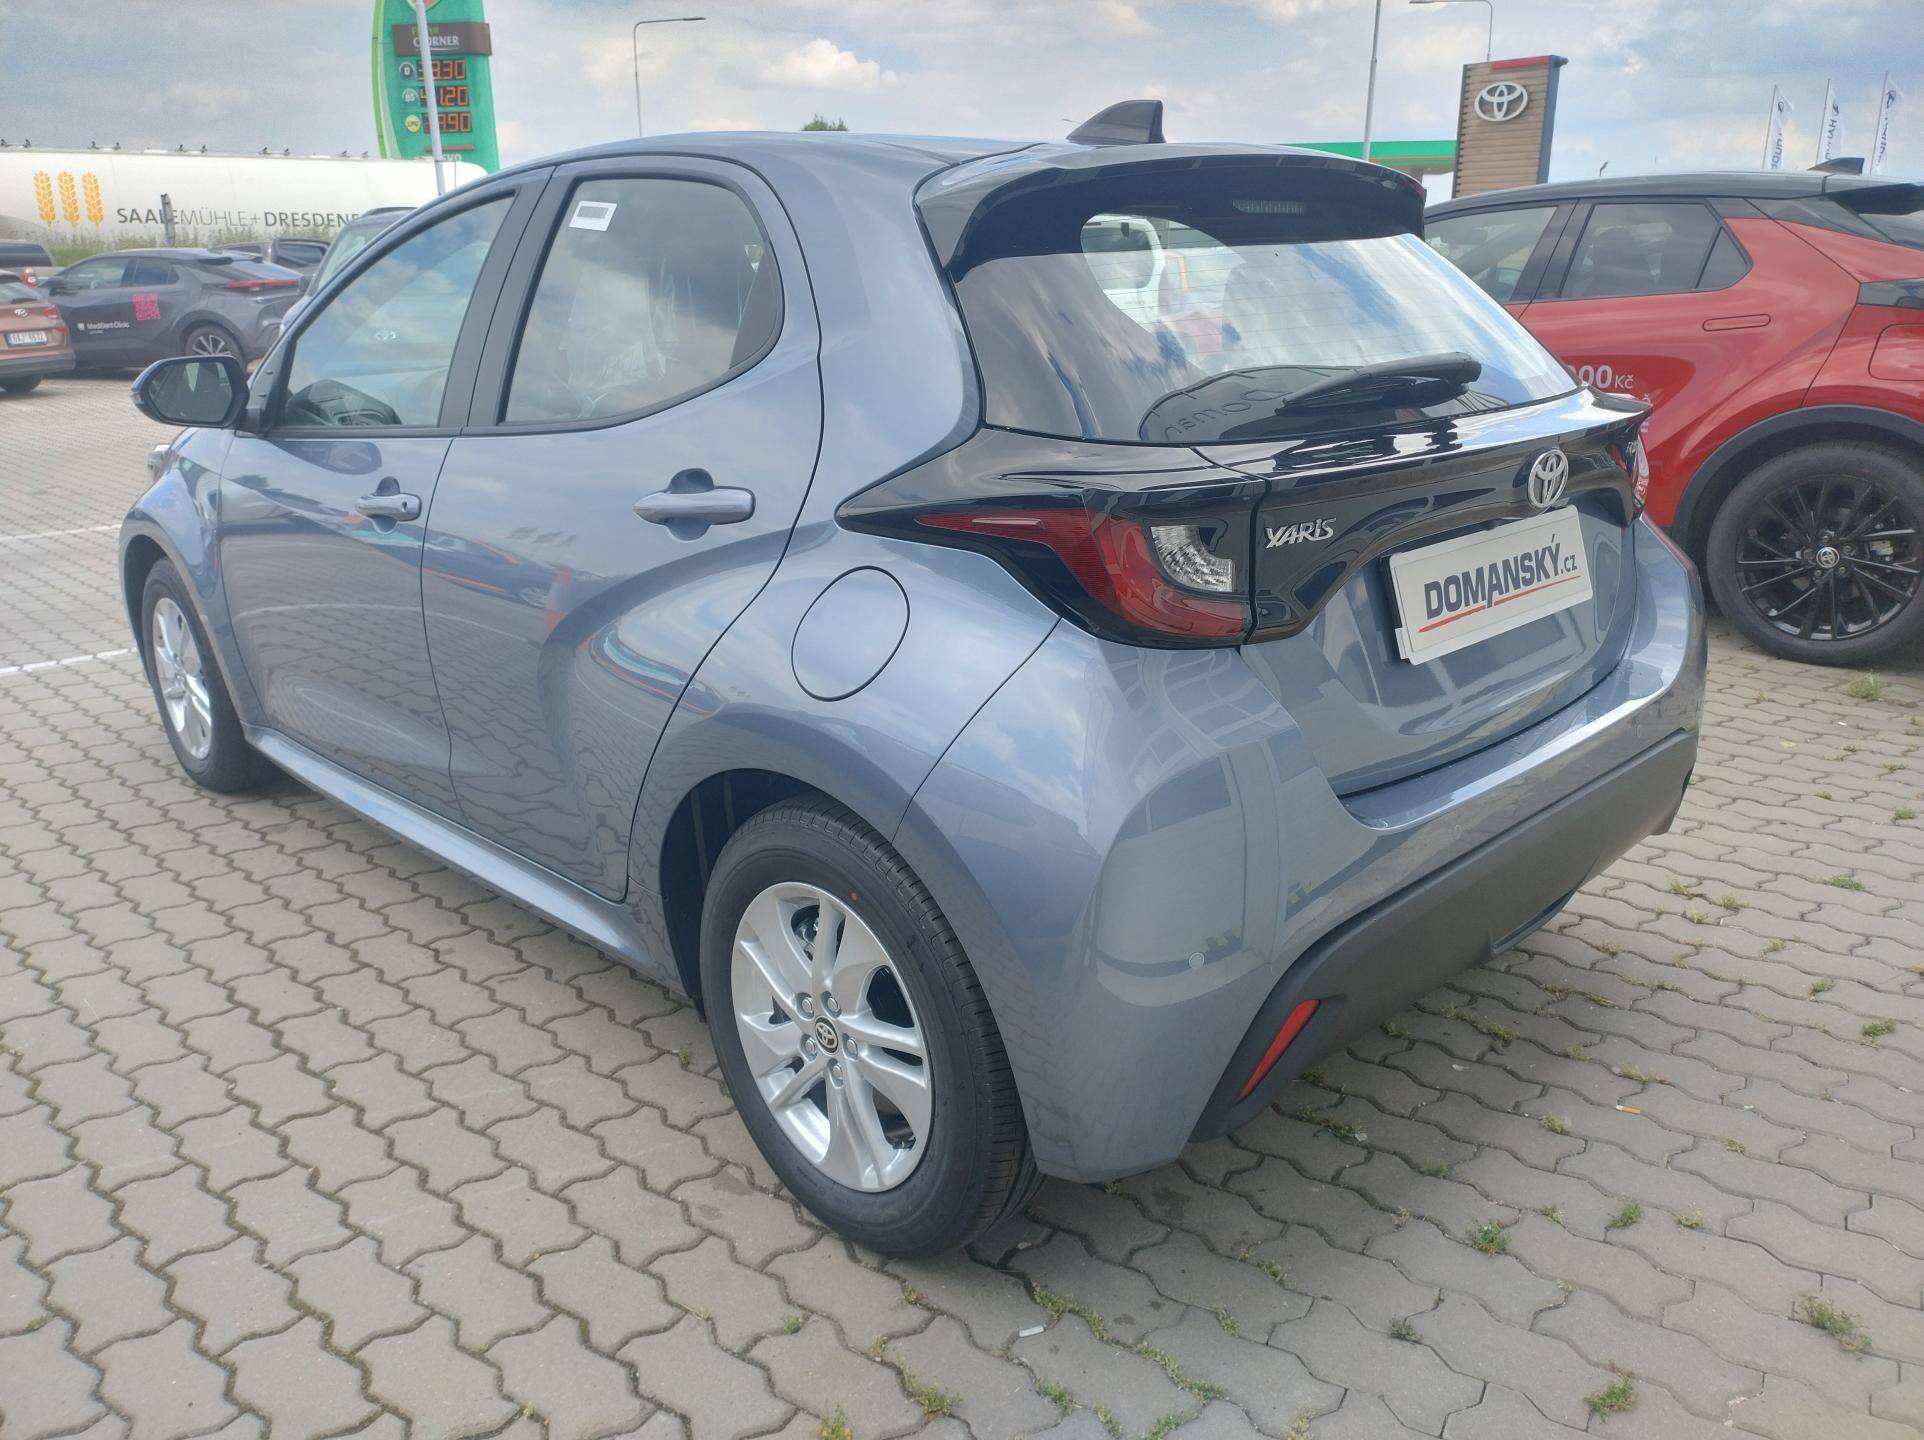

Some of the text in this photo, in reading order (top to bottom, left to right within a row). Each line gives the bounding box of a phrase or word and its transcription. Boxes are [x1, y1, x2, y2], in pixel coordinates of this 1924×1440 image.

[1568, 364, 1634, 389] 00 Kč
[1265, 517, 1337, 549] YARIS
